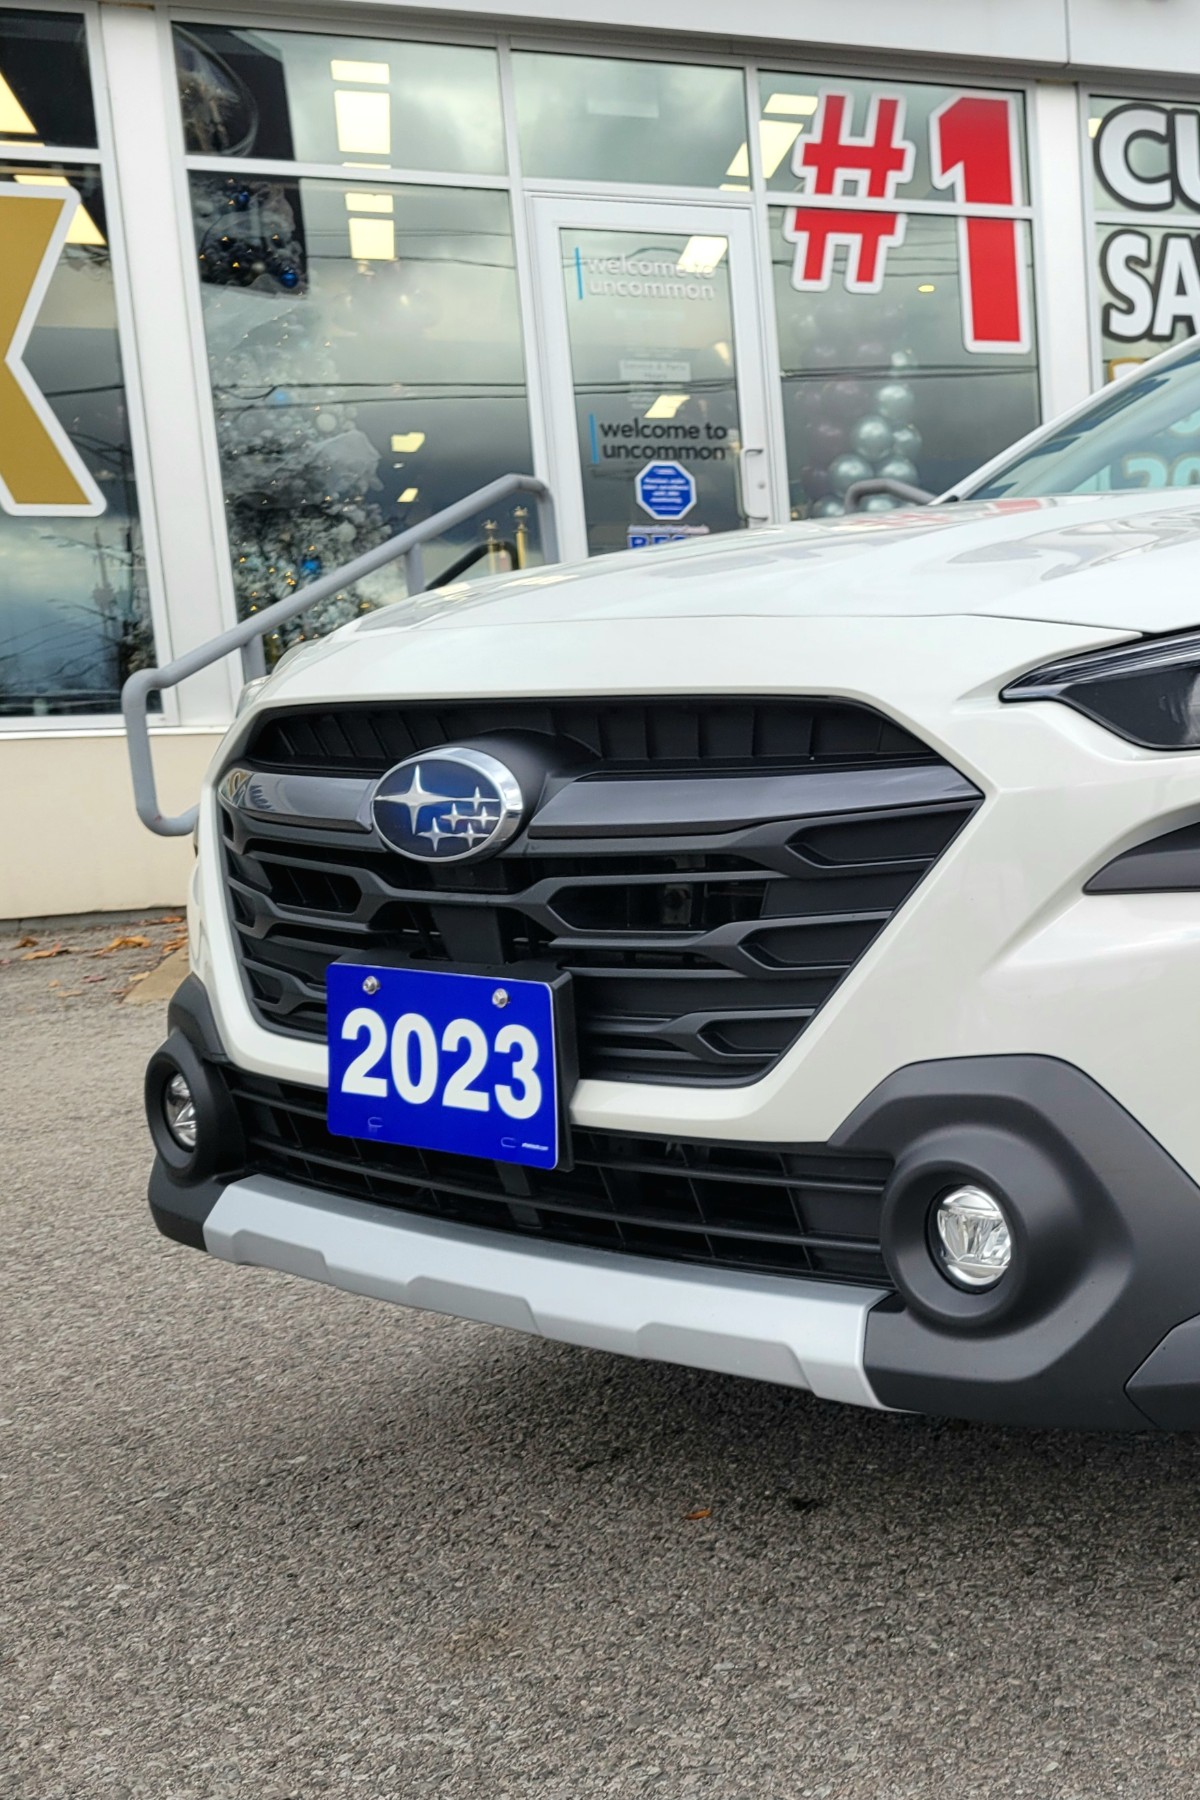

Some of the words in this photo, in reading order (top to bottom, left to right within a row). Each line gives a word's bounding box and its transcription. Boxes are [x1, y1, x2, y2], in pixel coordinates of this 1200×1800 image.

[787, 90, 1027, 349] #1
[587, 253, 688, 278] welcome
[694, 261, 715, 280] to
[590, 281, 715, 300] uncommon
[600, 418, 700, 440] welcome
[704, 422, 728, 440] to
[602, 444, 726, 461] uncommon
[341, 1007, 542, 1120] 2023
